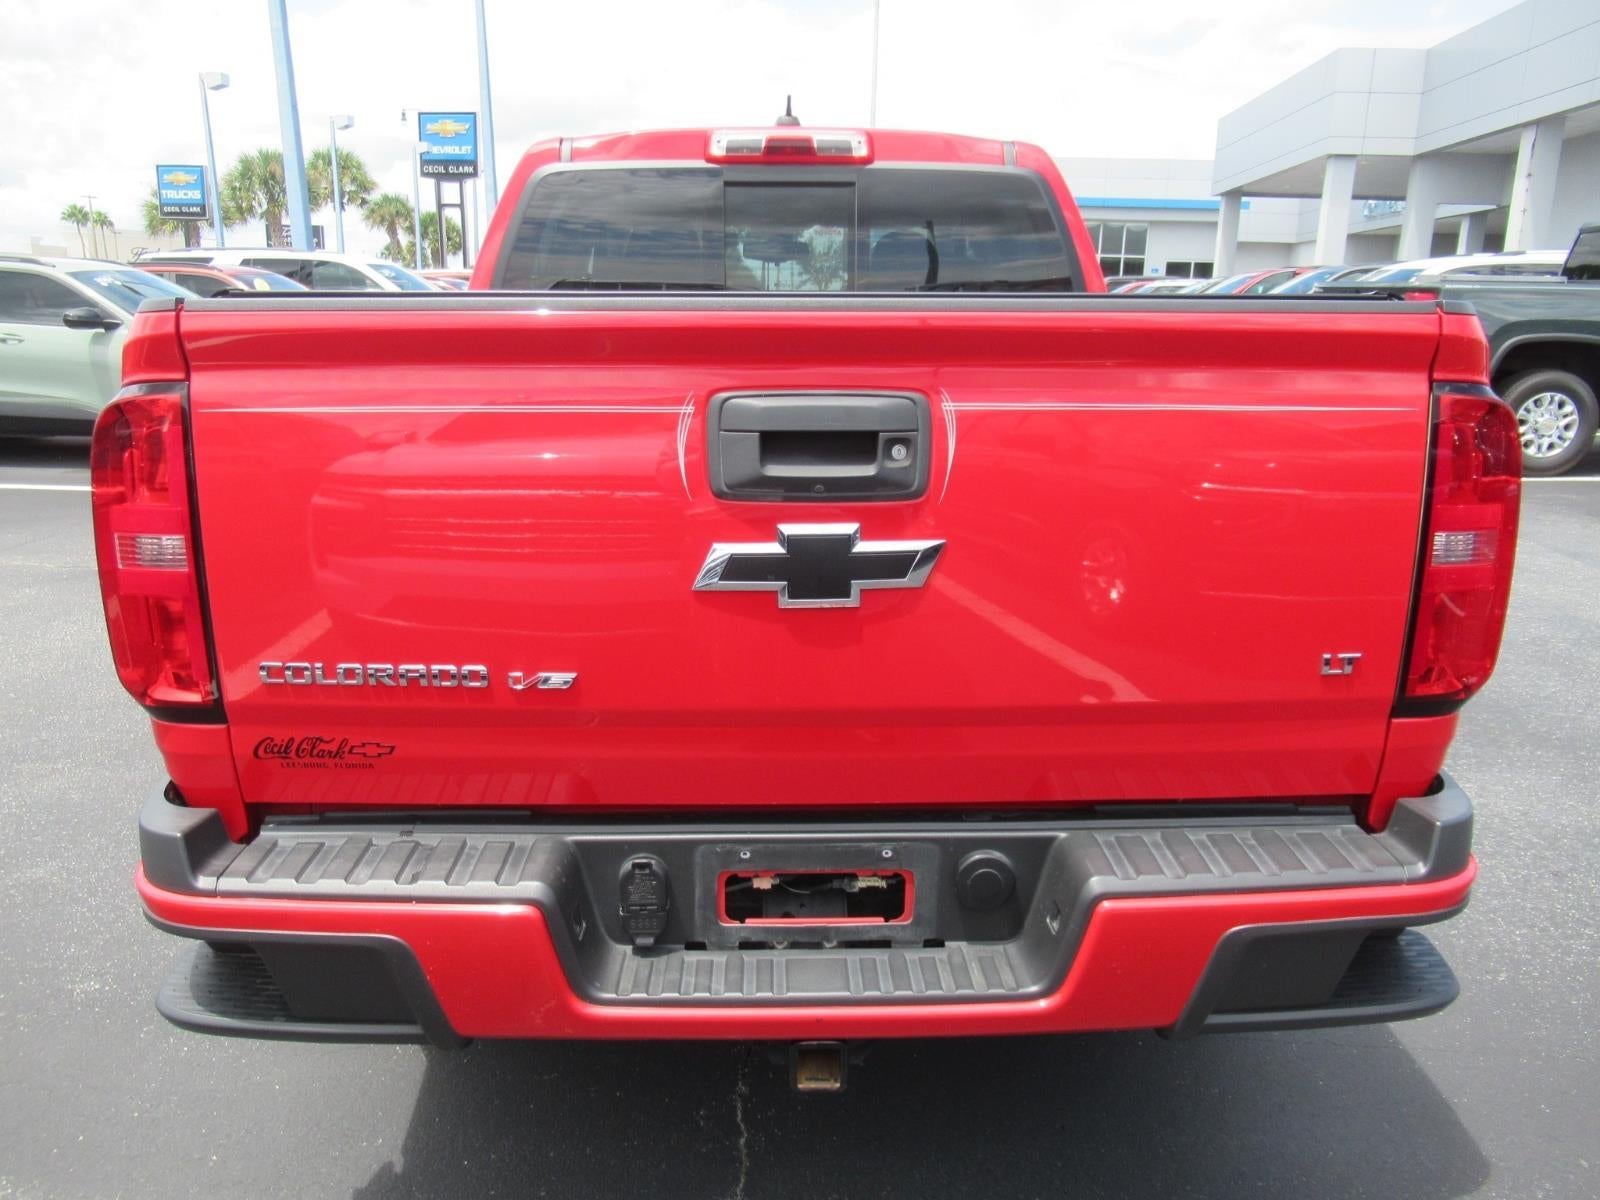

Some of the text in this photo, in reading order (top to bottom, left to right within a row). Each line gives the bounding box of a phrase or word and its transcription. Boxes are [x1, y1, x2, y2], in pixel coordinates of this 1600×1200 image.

[423, 165, 474, 174] CECIL CLARK
[161, 190, 201, 200] TRUCKS
[1320, 652, 1362, 675] LT
[259, 661, 578, 690] COLORADO V6
[253, 736, 349, 760] Cecil Clark
